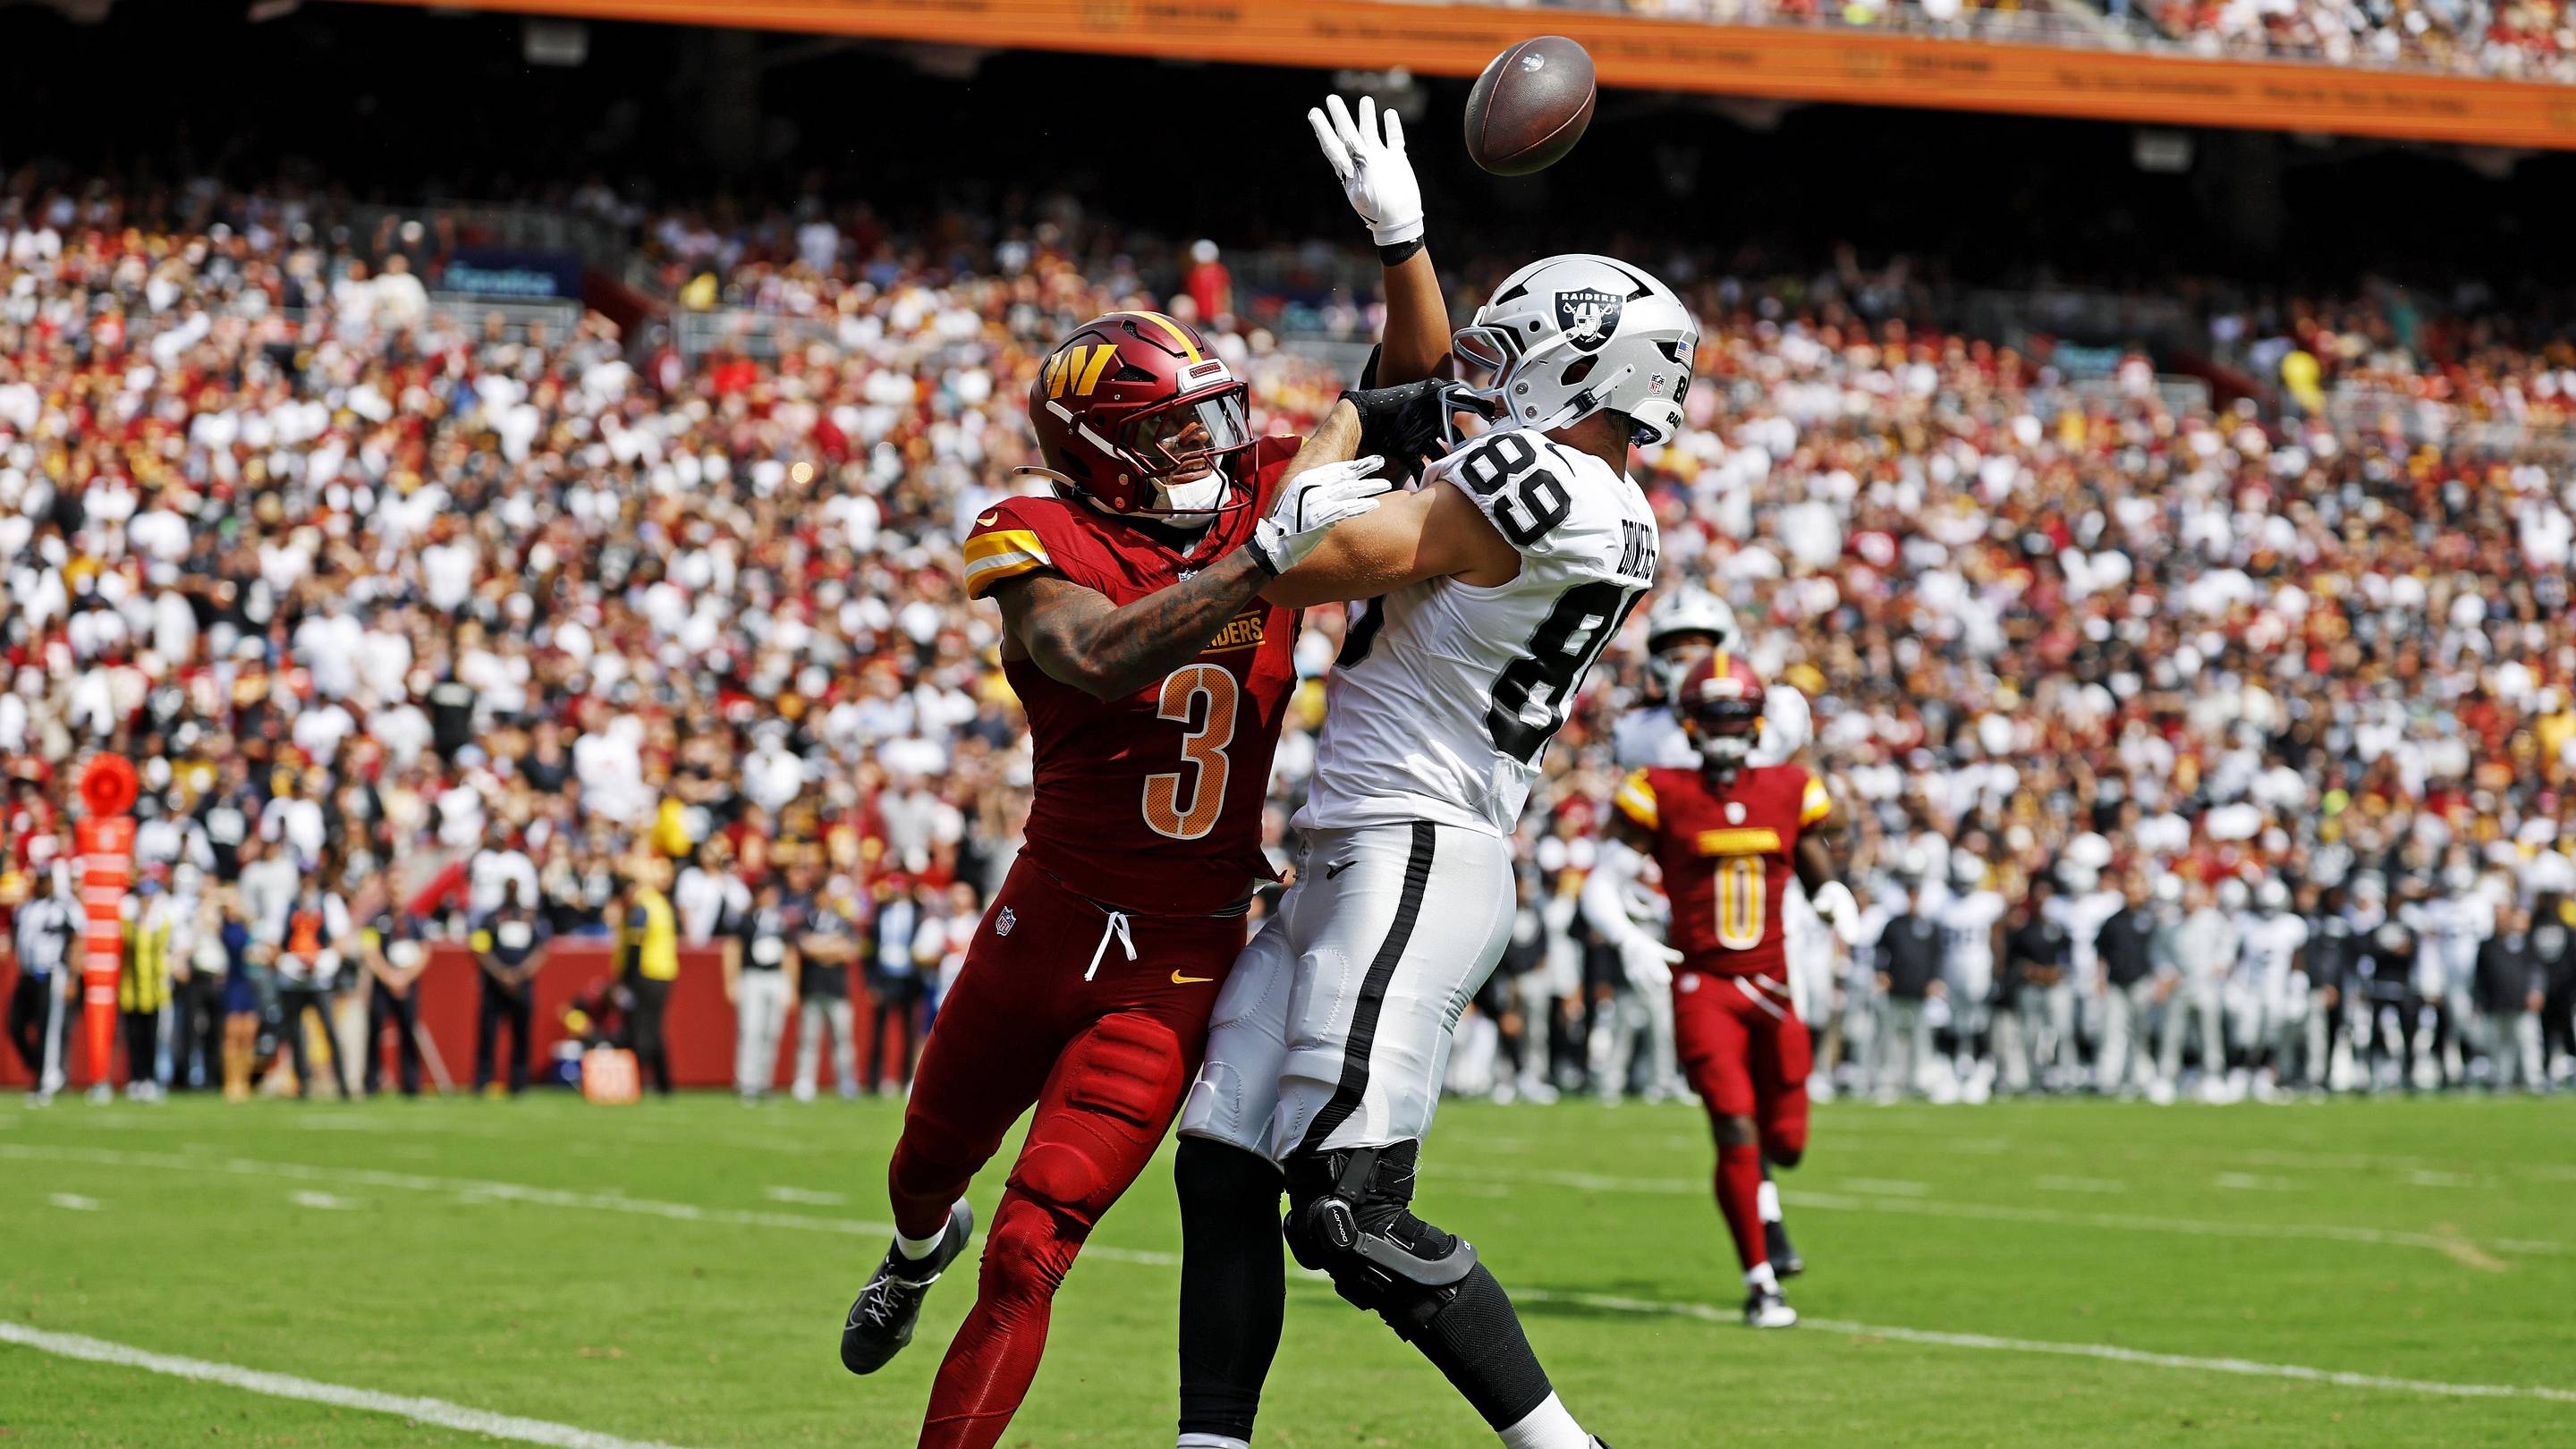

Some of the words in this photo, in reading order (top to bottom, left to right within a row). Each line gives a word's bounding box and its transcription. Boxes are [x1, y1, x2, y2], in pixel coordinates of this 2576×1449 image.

[1561, 292, 1617, 302] RAIDERS
[1460, 432, 1572, 547] 89
[1616, 519, 1656, 580] BOWERS
[1482, 580, 1648, 767] 8
[1141, 663, 1240, 841] 3
[1714, 853, 1767, 951] 0
[1332, 1208, 1349, 1242] DONJOY
